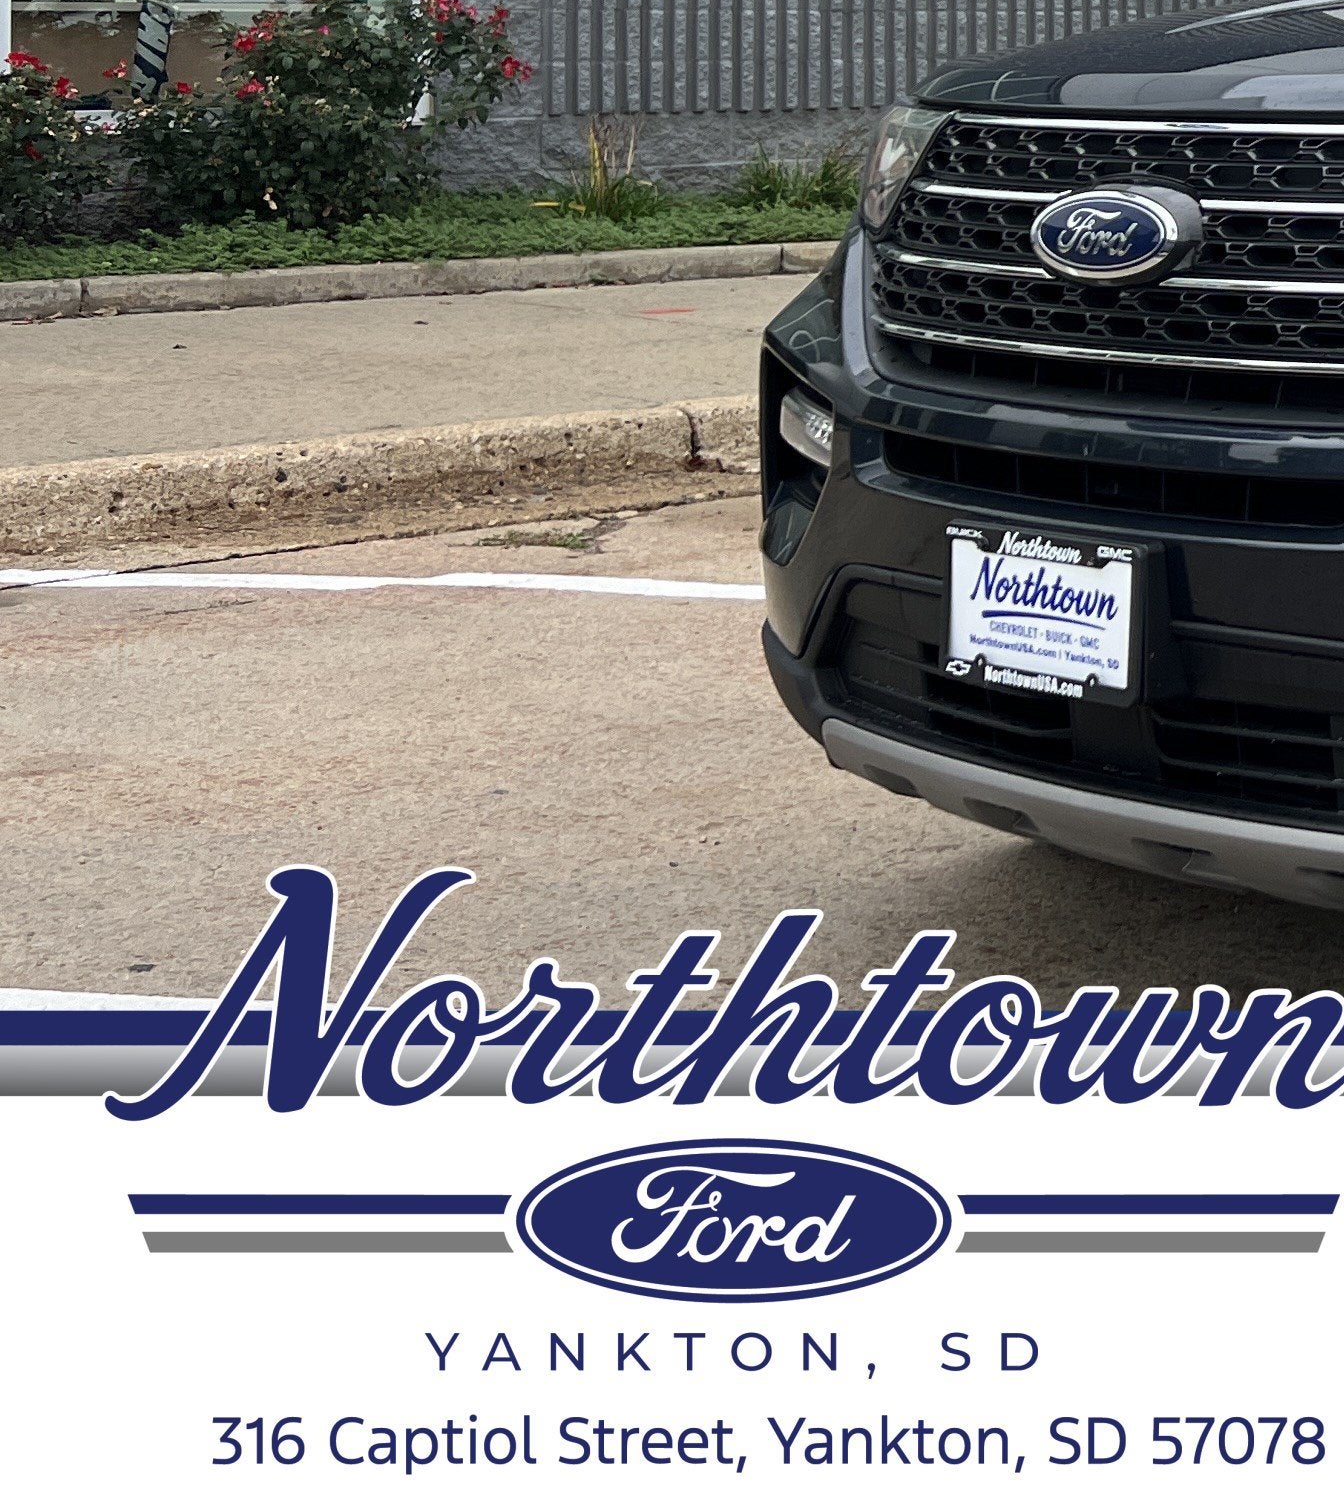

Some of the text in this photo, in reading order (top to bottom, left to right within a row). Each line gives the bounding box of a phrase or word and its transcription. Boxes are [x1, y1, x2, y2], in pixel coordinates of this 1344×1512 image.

[1056, 206, 1138, 257] Ford
[997, 530, 1083, 565] Northtown
[1096, 545, 1133, 562] GMC
[969, 555, 1119, 621] Northtown
[969, 633, 1057, 659] NorthtownUSA.com
[989, 620, 1100, 650] CHEVROLET BUICK GMC
[983, 664, 1084, 699] NorthtownUSA.com
